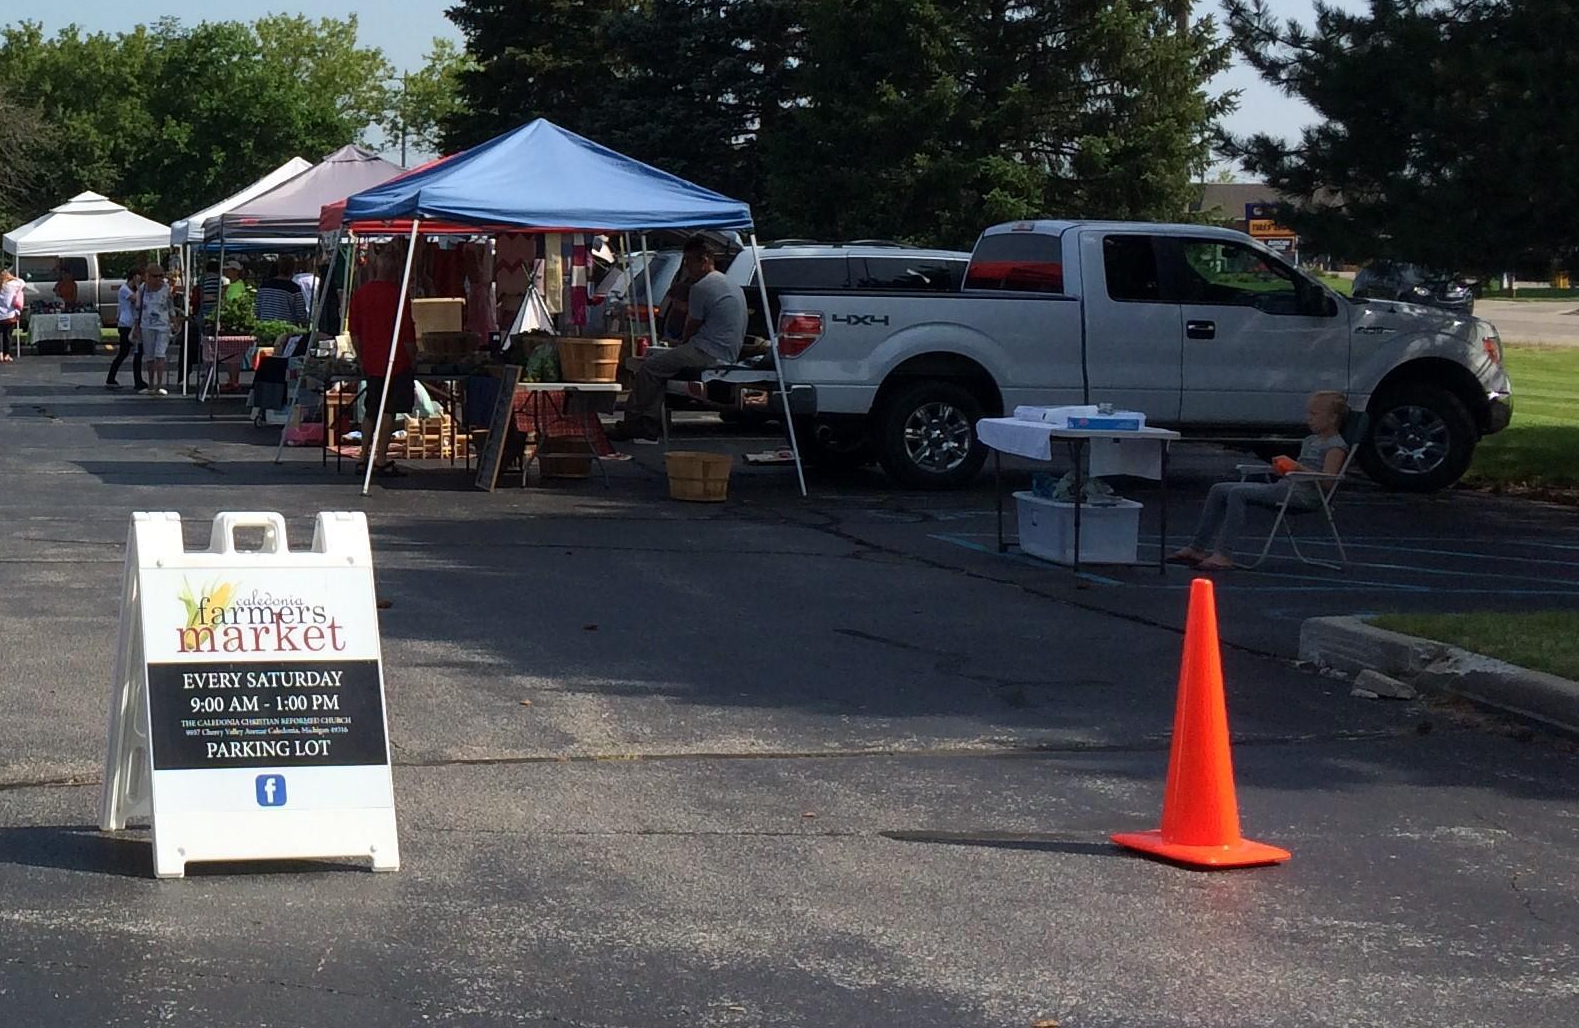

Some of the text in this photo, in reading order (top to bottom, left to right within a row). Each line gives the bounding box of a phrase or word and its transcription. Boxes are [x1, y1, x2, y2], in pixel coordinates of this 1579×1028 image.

[236, 589, 304, 607] caledonia
[197, 597, 327, 625] farmers
[176, 611, 347, 653] market
[183, 671, 343, 689] EVERY SATURDAY
[190, 696, 224, 713] 9:00
[228, 696, 259, 712] AM
[276, 695, 307, 711] 1:00
[311, 694, 340, 710] PM
[181, 716, 352, 727] THE CALEDONIA CHRISTIAN REFORMED CHURCH
[206, 739, 331, 759] PARKING LOT
